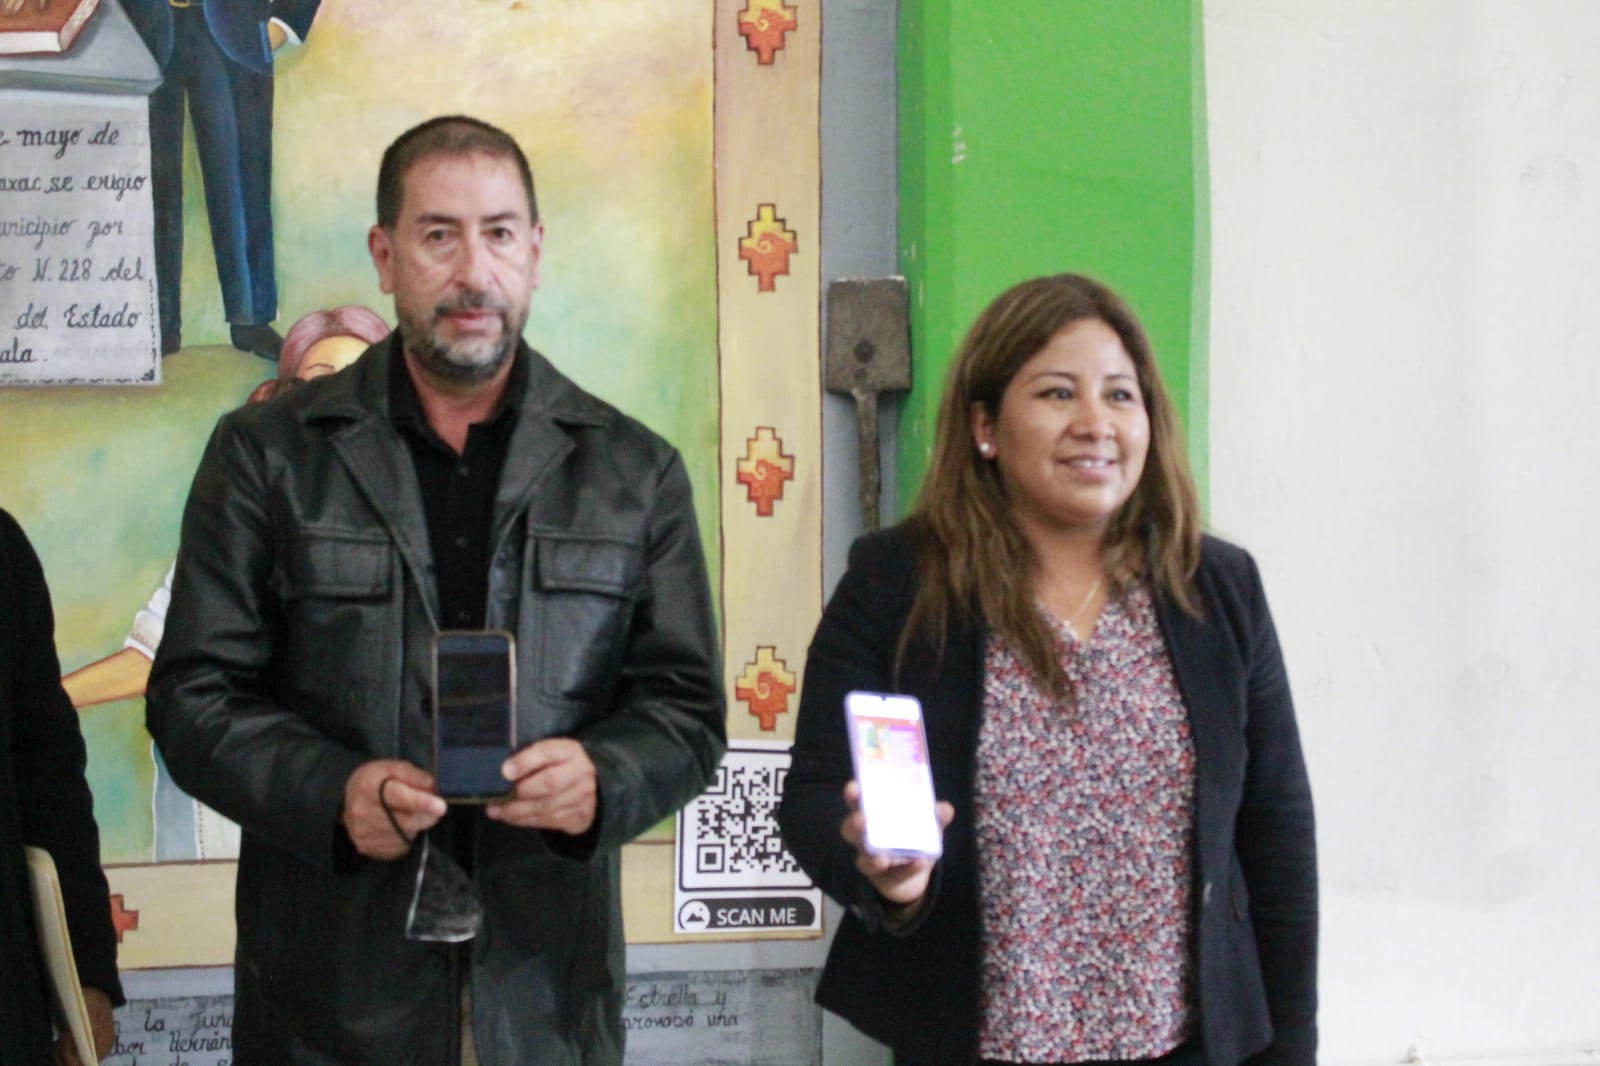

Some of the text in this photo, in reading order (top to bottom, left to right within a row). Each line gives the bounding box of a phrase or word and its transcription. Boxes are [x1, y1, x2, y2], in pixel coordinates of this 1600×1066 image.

[16, 128, 83, 160] mayo
[87, 120, 120, 146] de
[86, 220, 124, 248] por
[58, 257, 92, 281] 228
[100, 256, 145, 281] del
[14, 301, 141, 330] del Estado
[716, 907, 797, 926] SCAN ME
[144, 1010, 167, 1033] la
